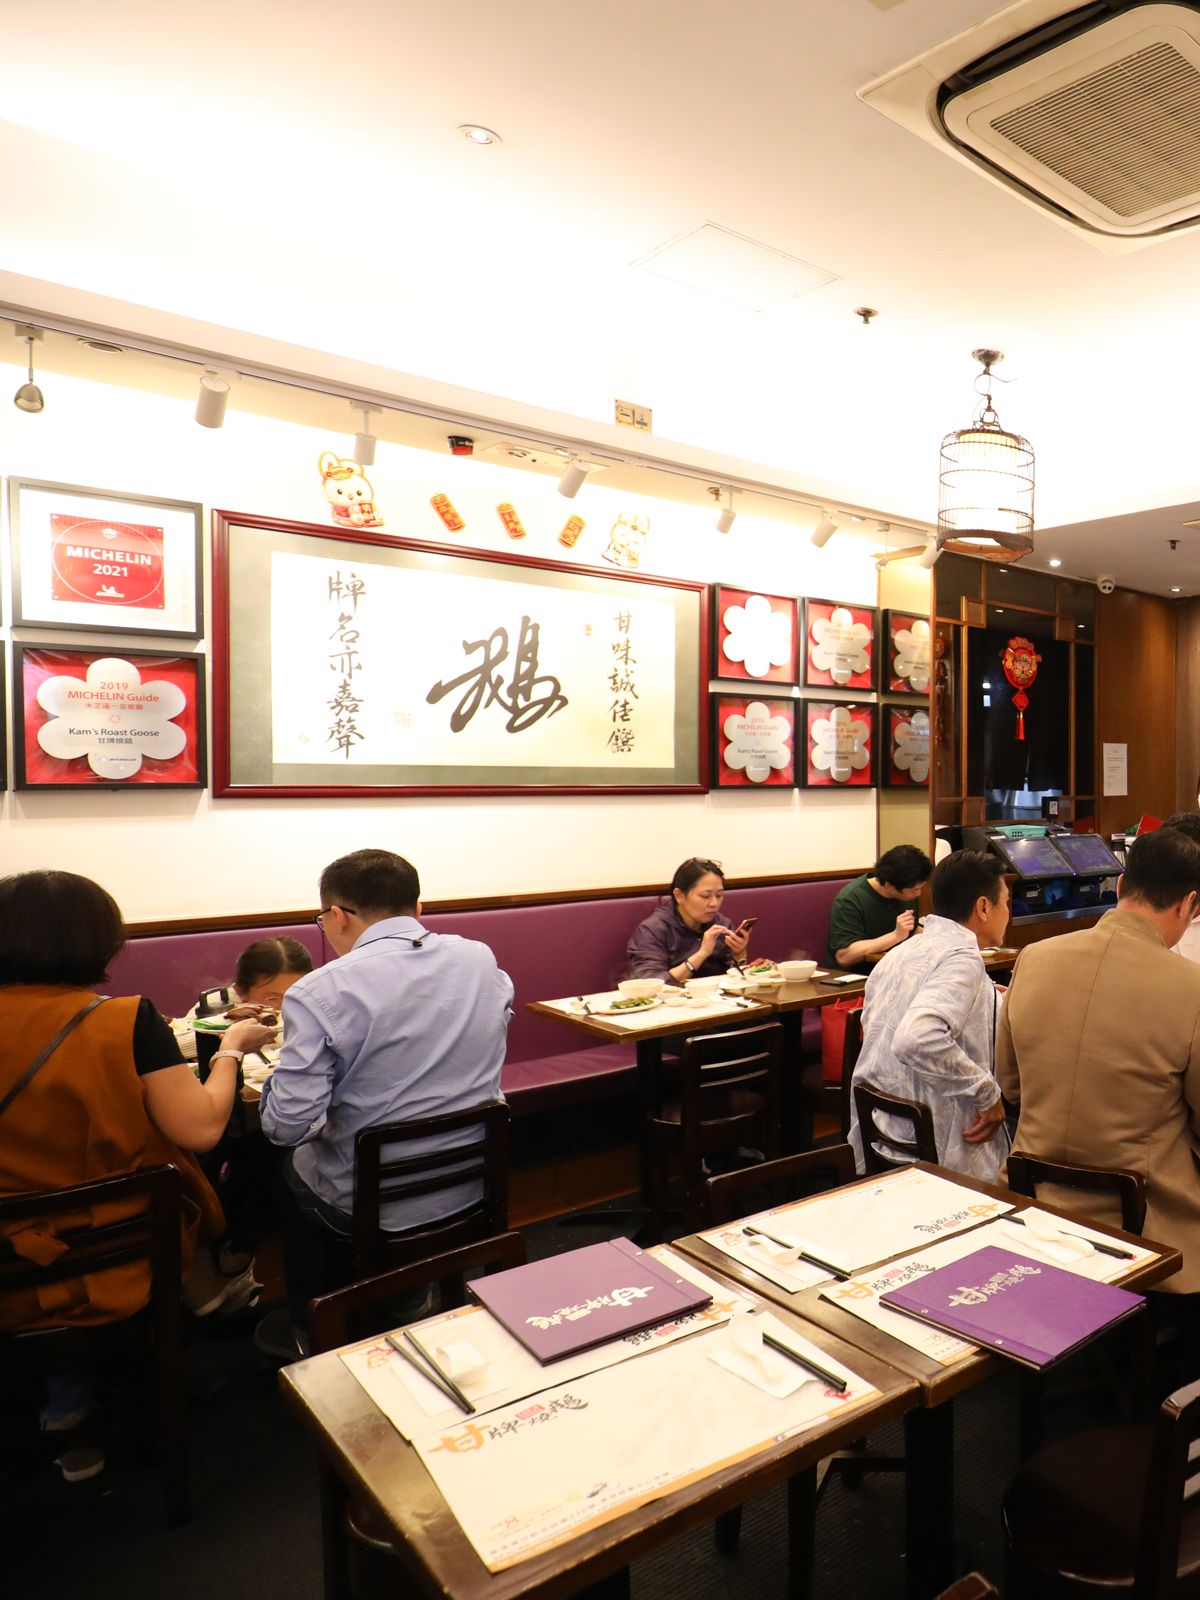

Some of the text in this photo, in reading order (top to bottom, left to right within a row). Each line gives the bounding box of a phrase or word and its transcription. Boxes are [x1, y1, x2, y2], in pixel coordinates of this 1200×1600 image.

[66, 546, 152, 565] MICHELIN
[92, 564, 129, 577] 2021
[100, 681, 129, 690] 2019
[68, 691, 160, 702] MICHELIN Guide
[69, 728, 99, 736] Kam's
[101, 728, 127, 736] Roast
